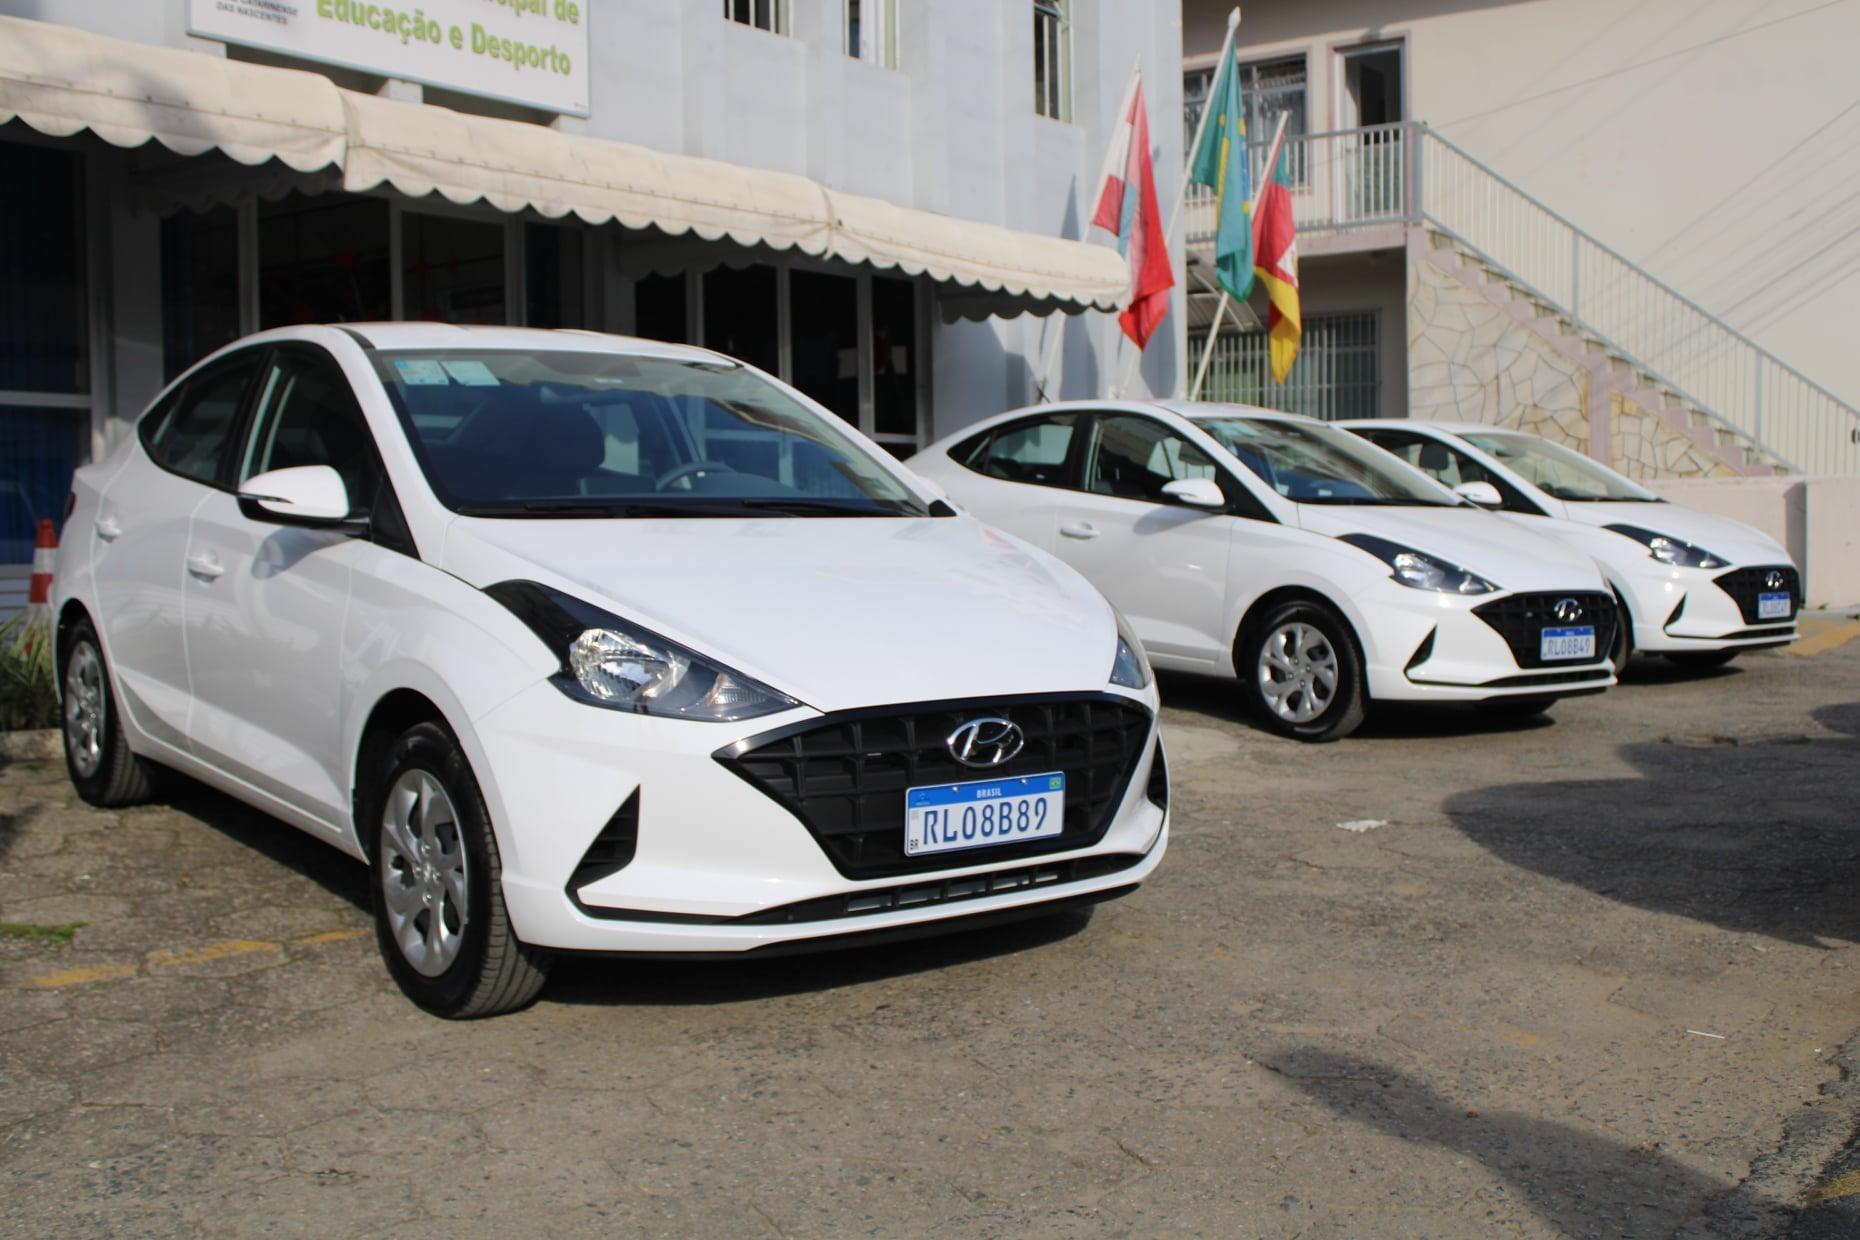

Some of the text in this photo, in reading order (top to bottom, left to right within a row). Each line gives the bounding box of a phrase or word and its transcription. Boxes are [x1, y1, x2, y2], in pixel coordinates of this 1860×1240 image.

[554, 0, 579, 25] de
[317, 0, 571, 76] Educação e Desporto
[976, 788, 1002, 799] BRASIL
